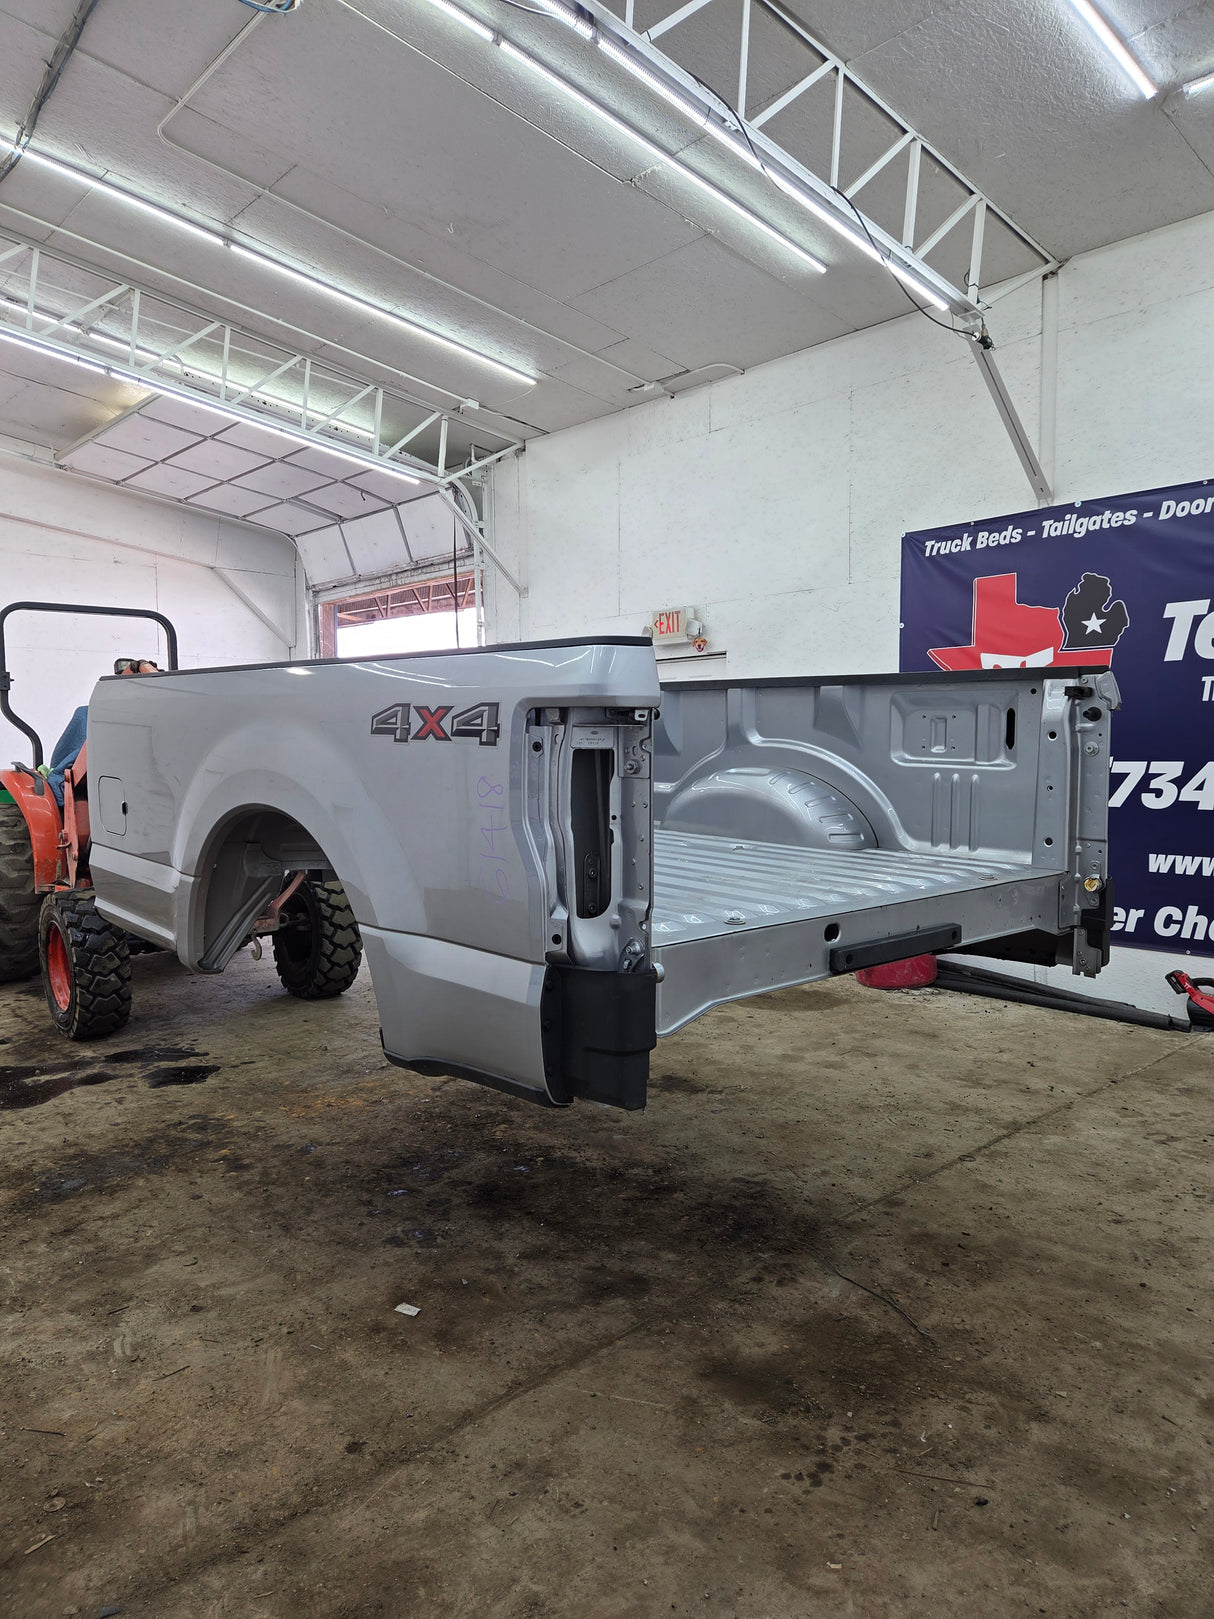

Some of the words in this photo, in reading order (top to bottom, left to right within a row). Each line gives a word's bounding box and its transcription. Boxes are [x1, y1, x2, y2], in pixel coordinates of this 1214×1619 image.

[924, 533, 973, 557] Truck
[975, 525, 1022, 549] Beds
[1041, 508, 1138, 538] Tailgates
[658, 610, 680, 635] EXIT
[1108, 757, 1214, 811] 734
